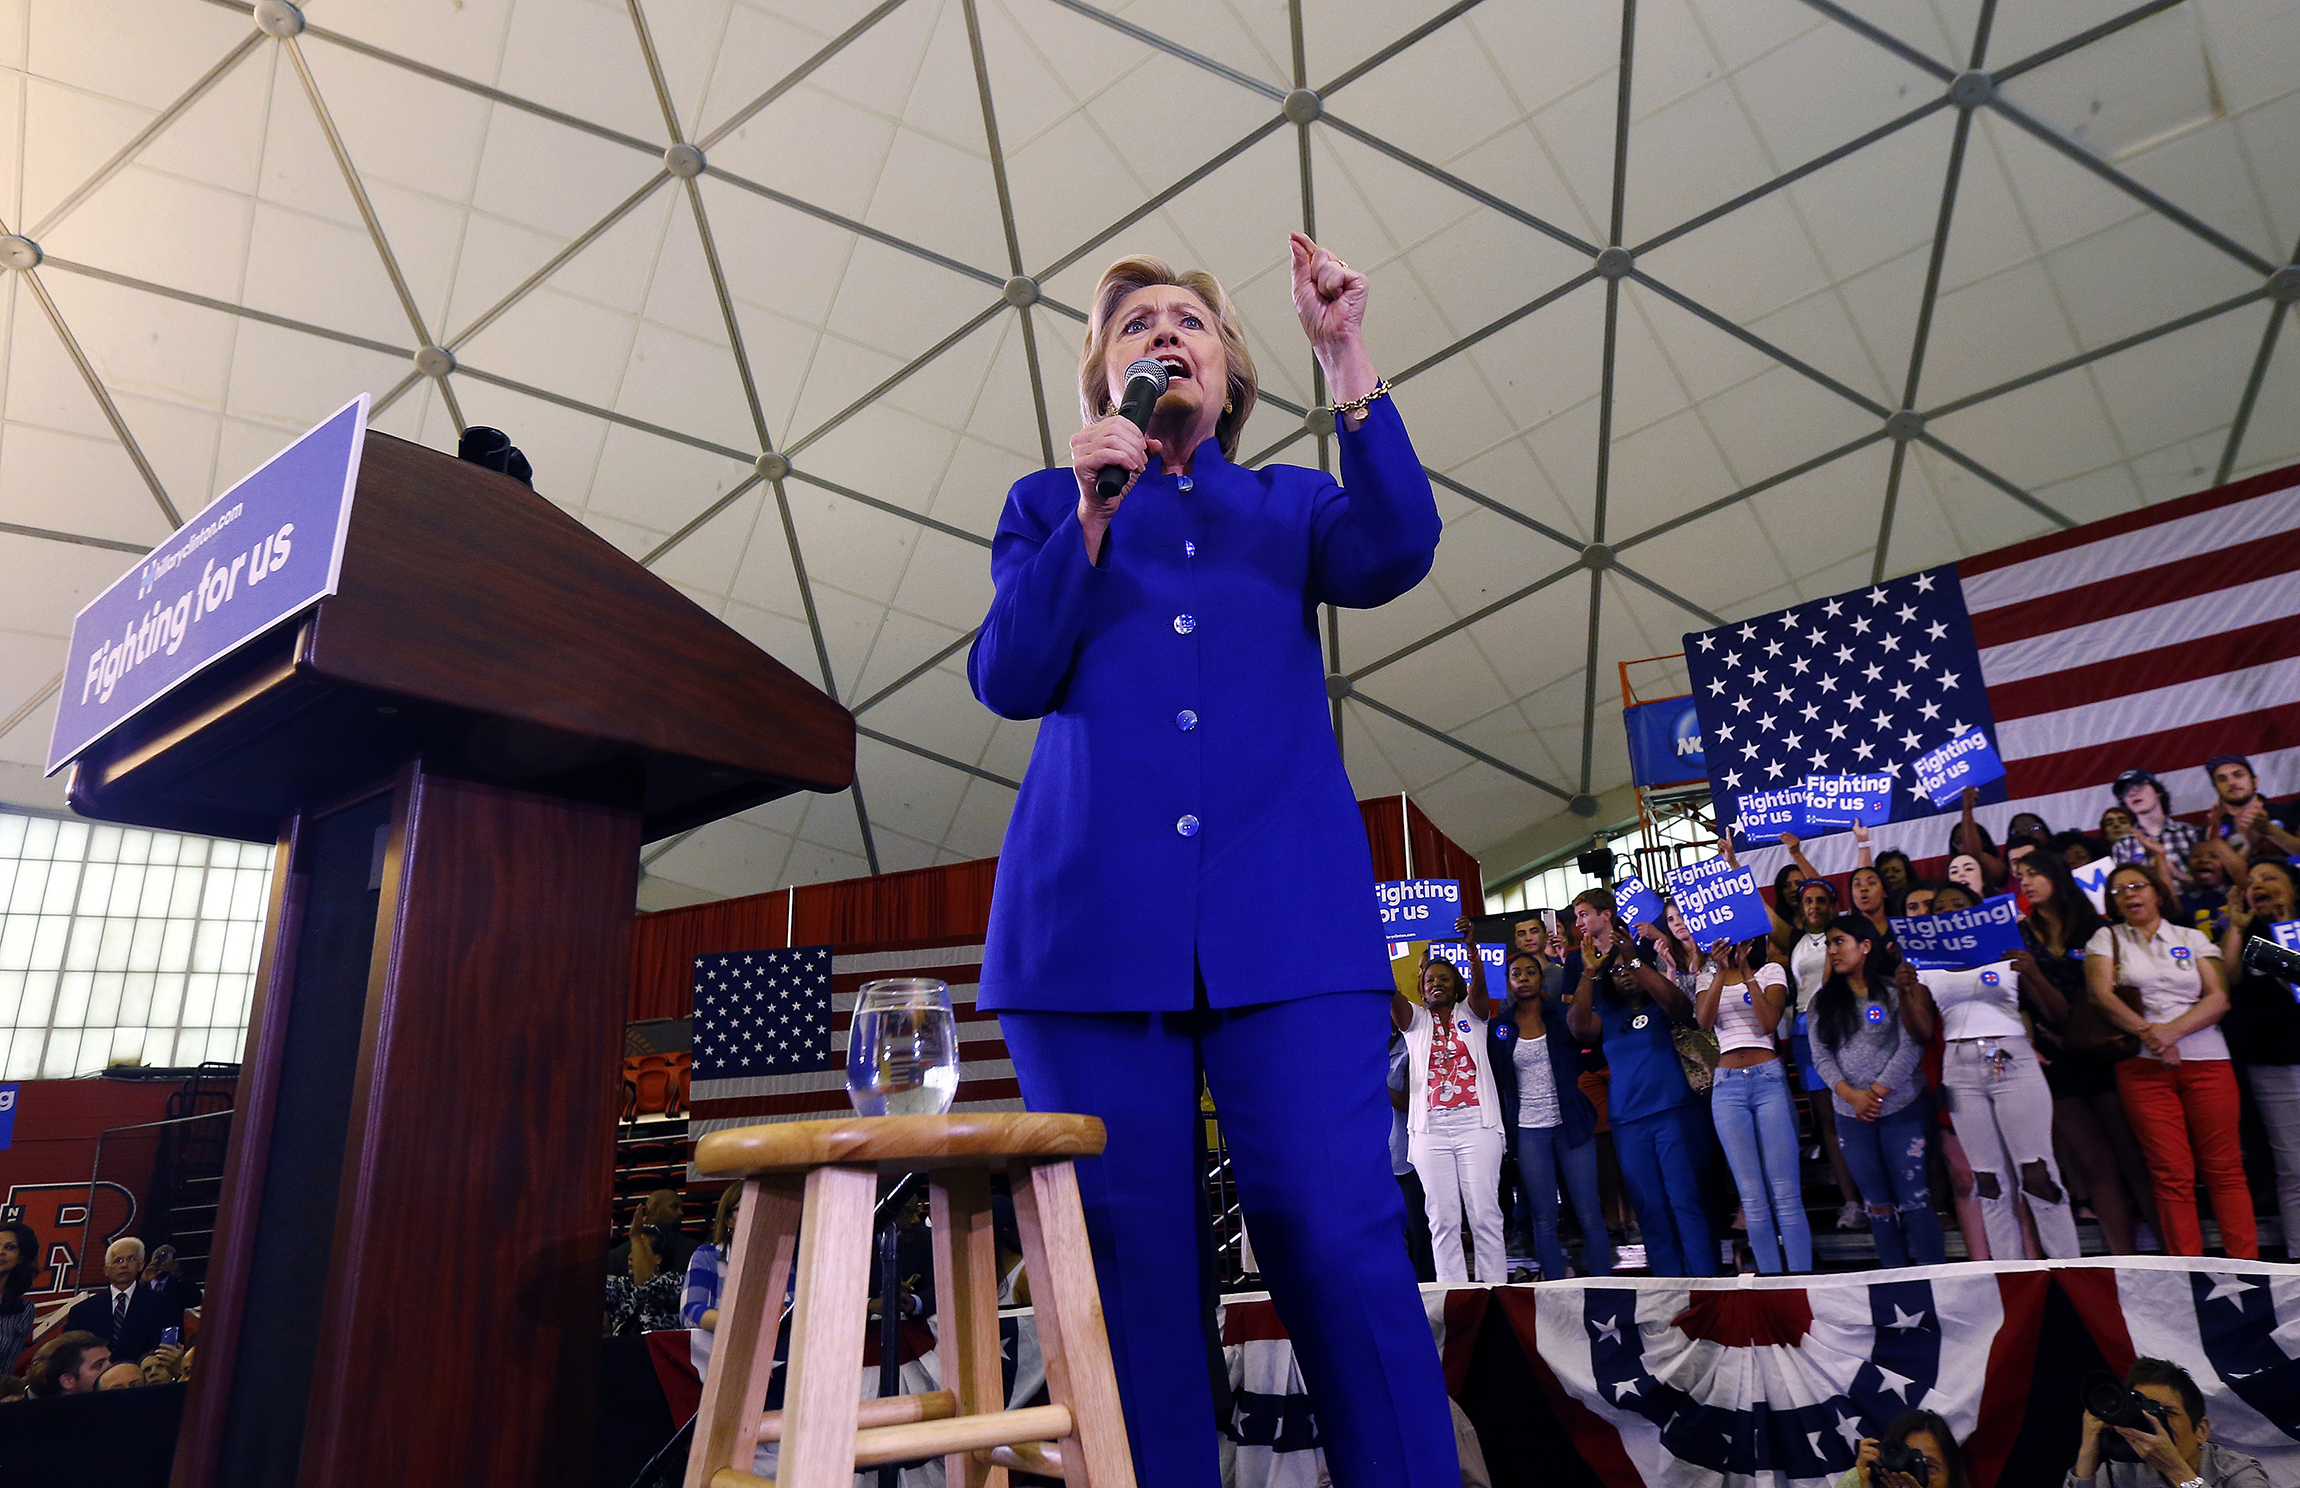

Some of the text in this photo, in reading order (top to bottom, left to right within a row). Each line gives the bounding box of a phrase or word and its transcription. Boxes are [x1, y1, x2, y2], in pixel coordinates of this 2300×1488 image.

[81, 522, 295, 706] Fighting for us
[1677, 735, 1704, 756] NC
[1912, 730, 1988, 778] Fighting
[1805, 774, 1892, 797] Fighting
[1922, 759, 1971, 793] for us
[1805, 791, 1866, 811] for us
[1741, 810, 1793, 827] for us
[1674, 871, 1756, 914] Fighting
[1380, 904, 1430, 923] or us
[1620, 904, 1640, 925] us
[1683, 904, 1735, 934] for us
[1889, 903, 2011, 939] Fighting
[1896, 934, 1979, 952] for us
[1429, 943, 1505, 967] Fighing
